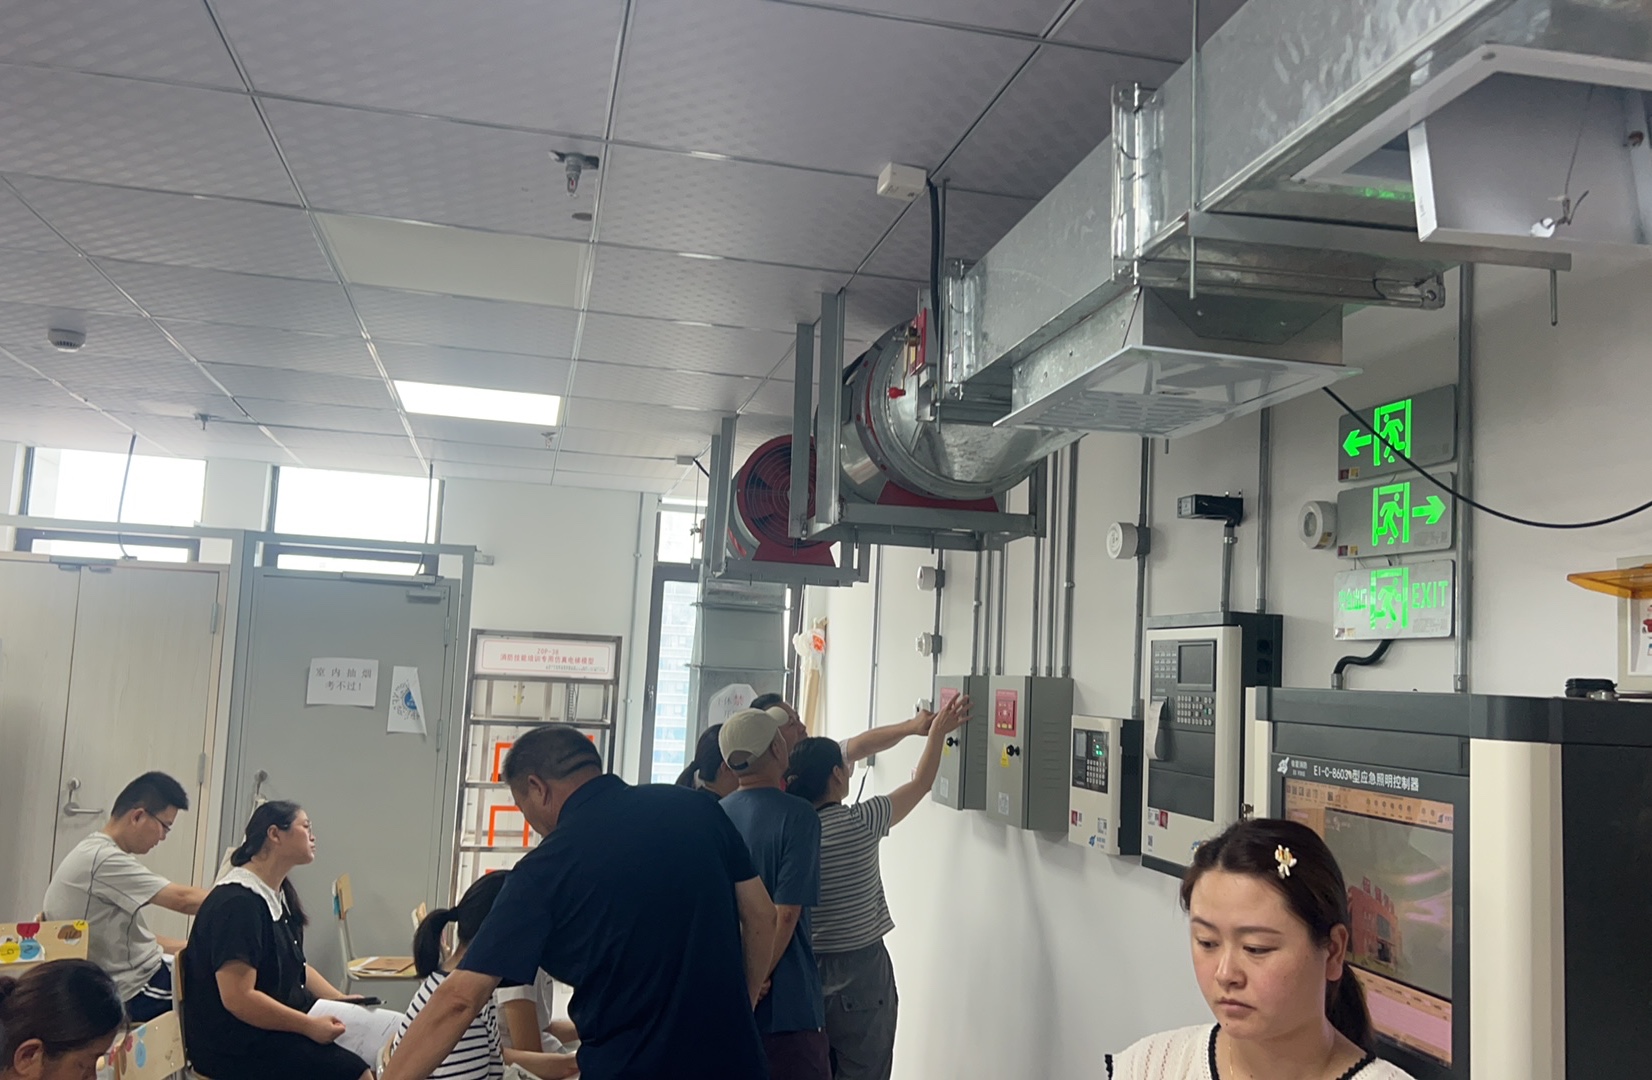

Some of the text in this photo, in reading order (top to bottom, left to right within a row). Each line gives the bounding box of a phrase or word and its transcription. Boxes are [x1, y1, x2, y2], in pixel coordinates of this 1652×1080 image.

[1411, 580, 1449, 609] EXIT
[315, 667, 373, 679] 室内抽烟
